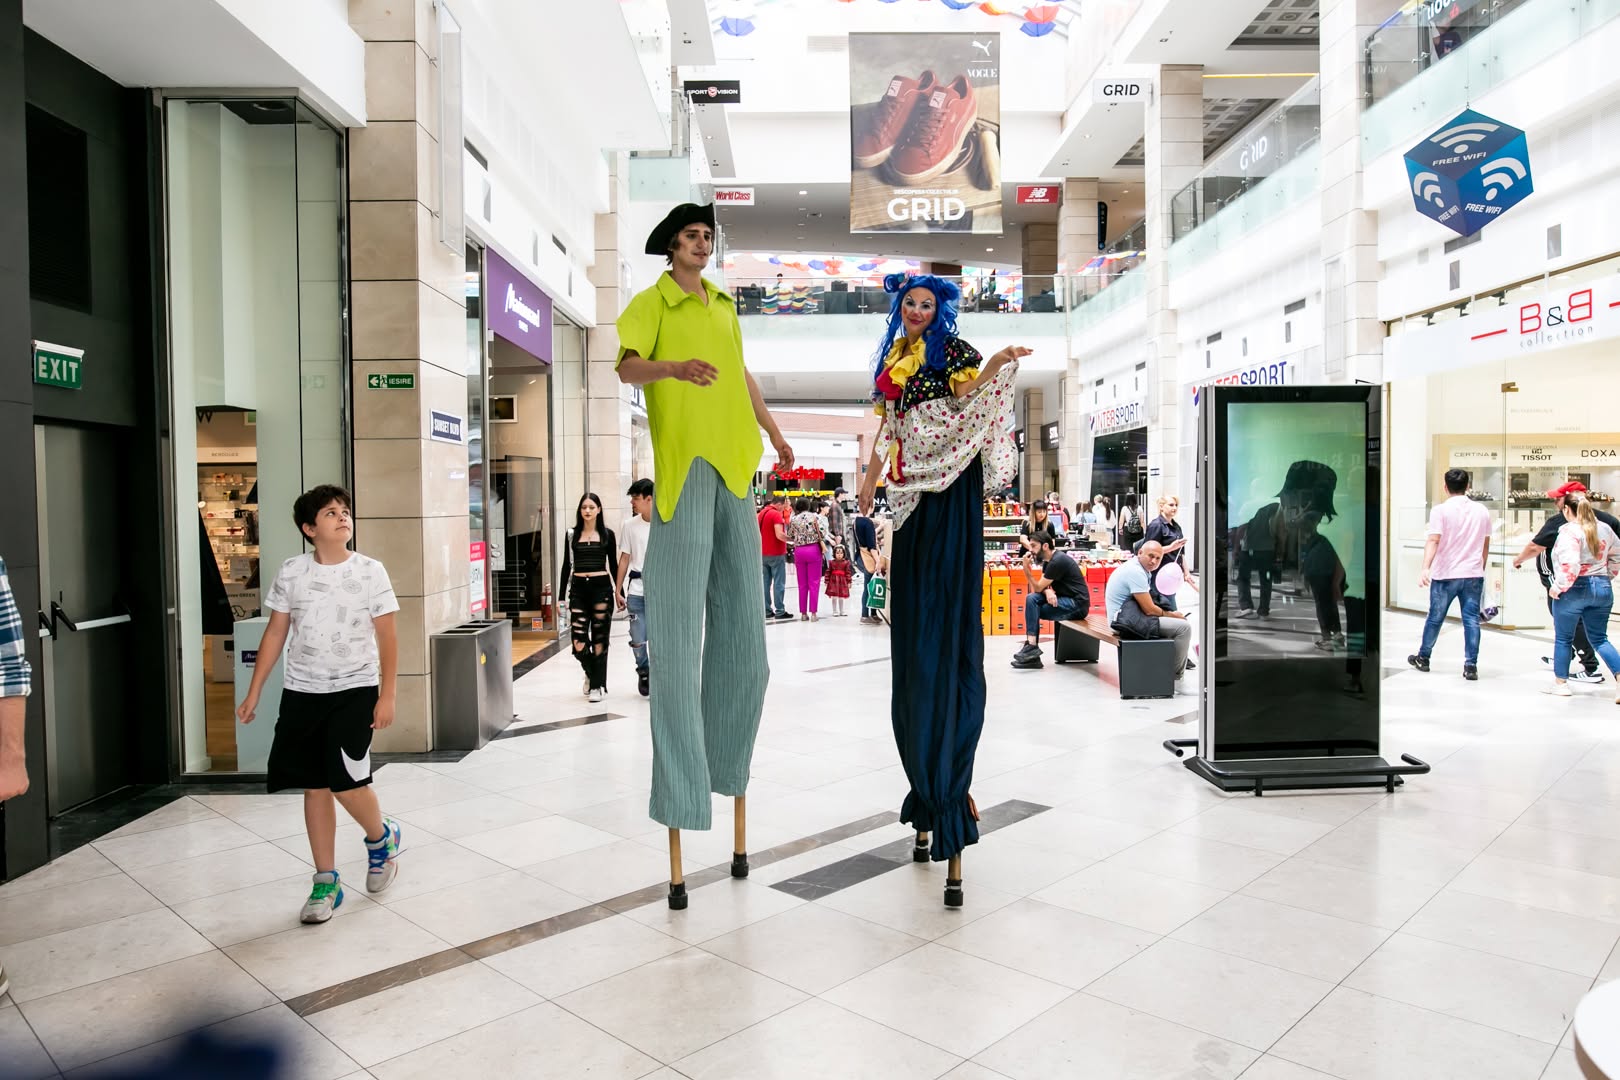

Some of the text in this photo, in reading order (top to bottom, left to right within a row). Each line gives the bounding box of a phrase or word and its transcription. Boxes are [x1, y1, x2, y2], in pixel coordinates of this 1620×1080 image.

[967, 68, 998, 78] VOGUE
[717, 88, 739, 96] VISION
[1102, 84, 1140, 97] GRID
[1432, 151, 1487, 166] FREE WIFI
[715, 191, 750, 200] World Class
[887, 197, 966, 221] GRID
[1438, 205, 1460, 222] FREE WIFI
[1464, 202, 1503, 215] FREE WIFI
[1519, 325, 1593, 348] collection
[38, 355, 79, 383] EXIT
[1581, 449, 1617, 458] DOXA
